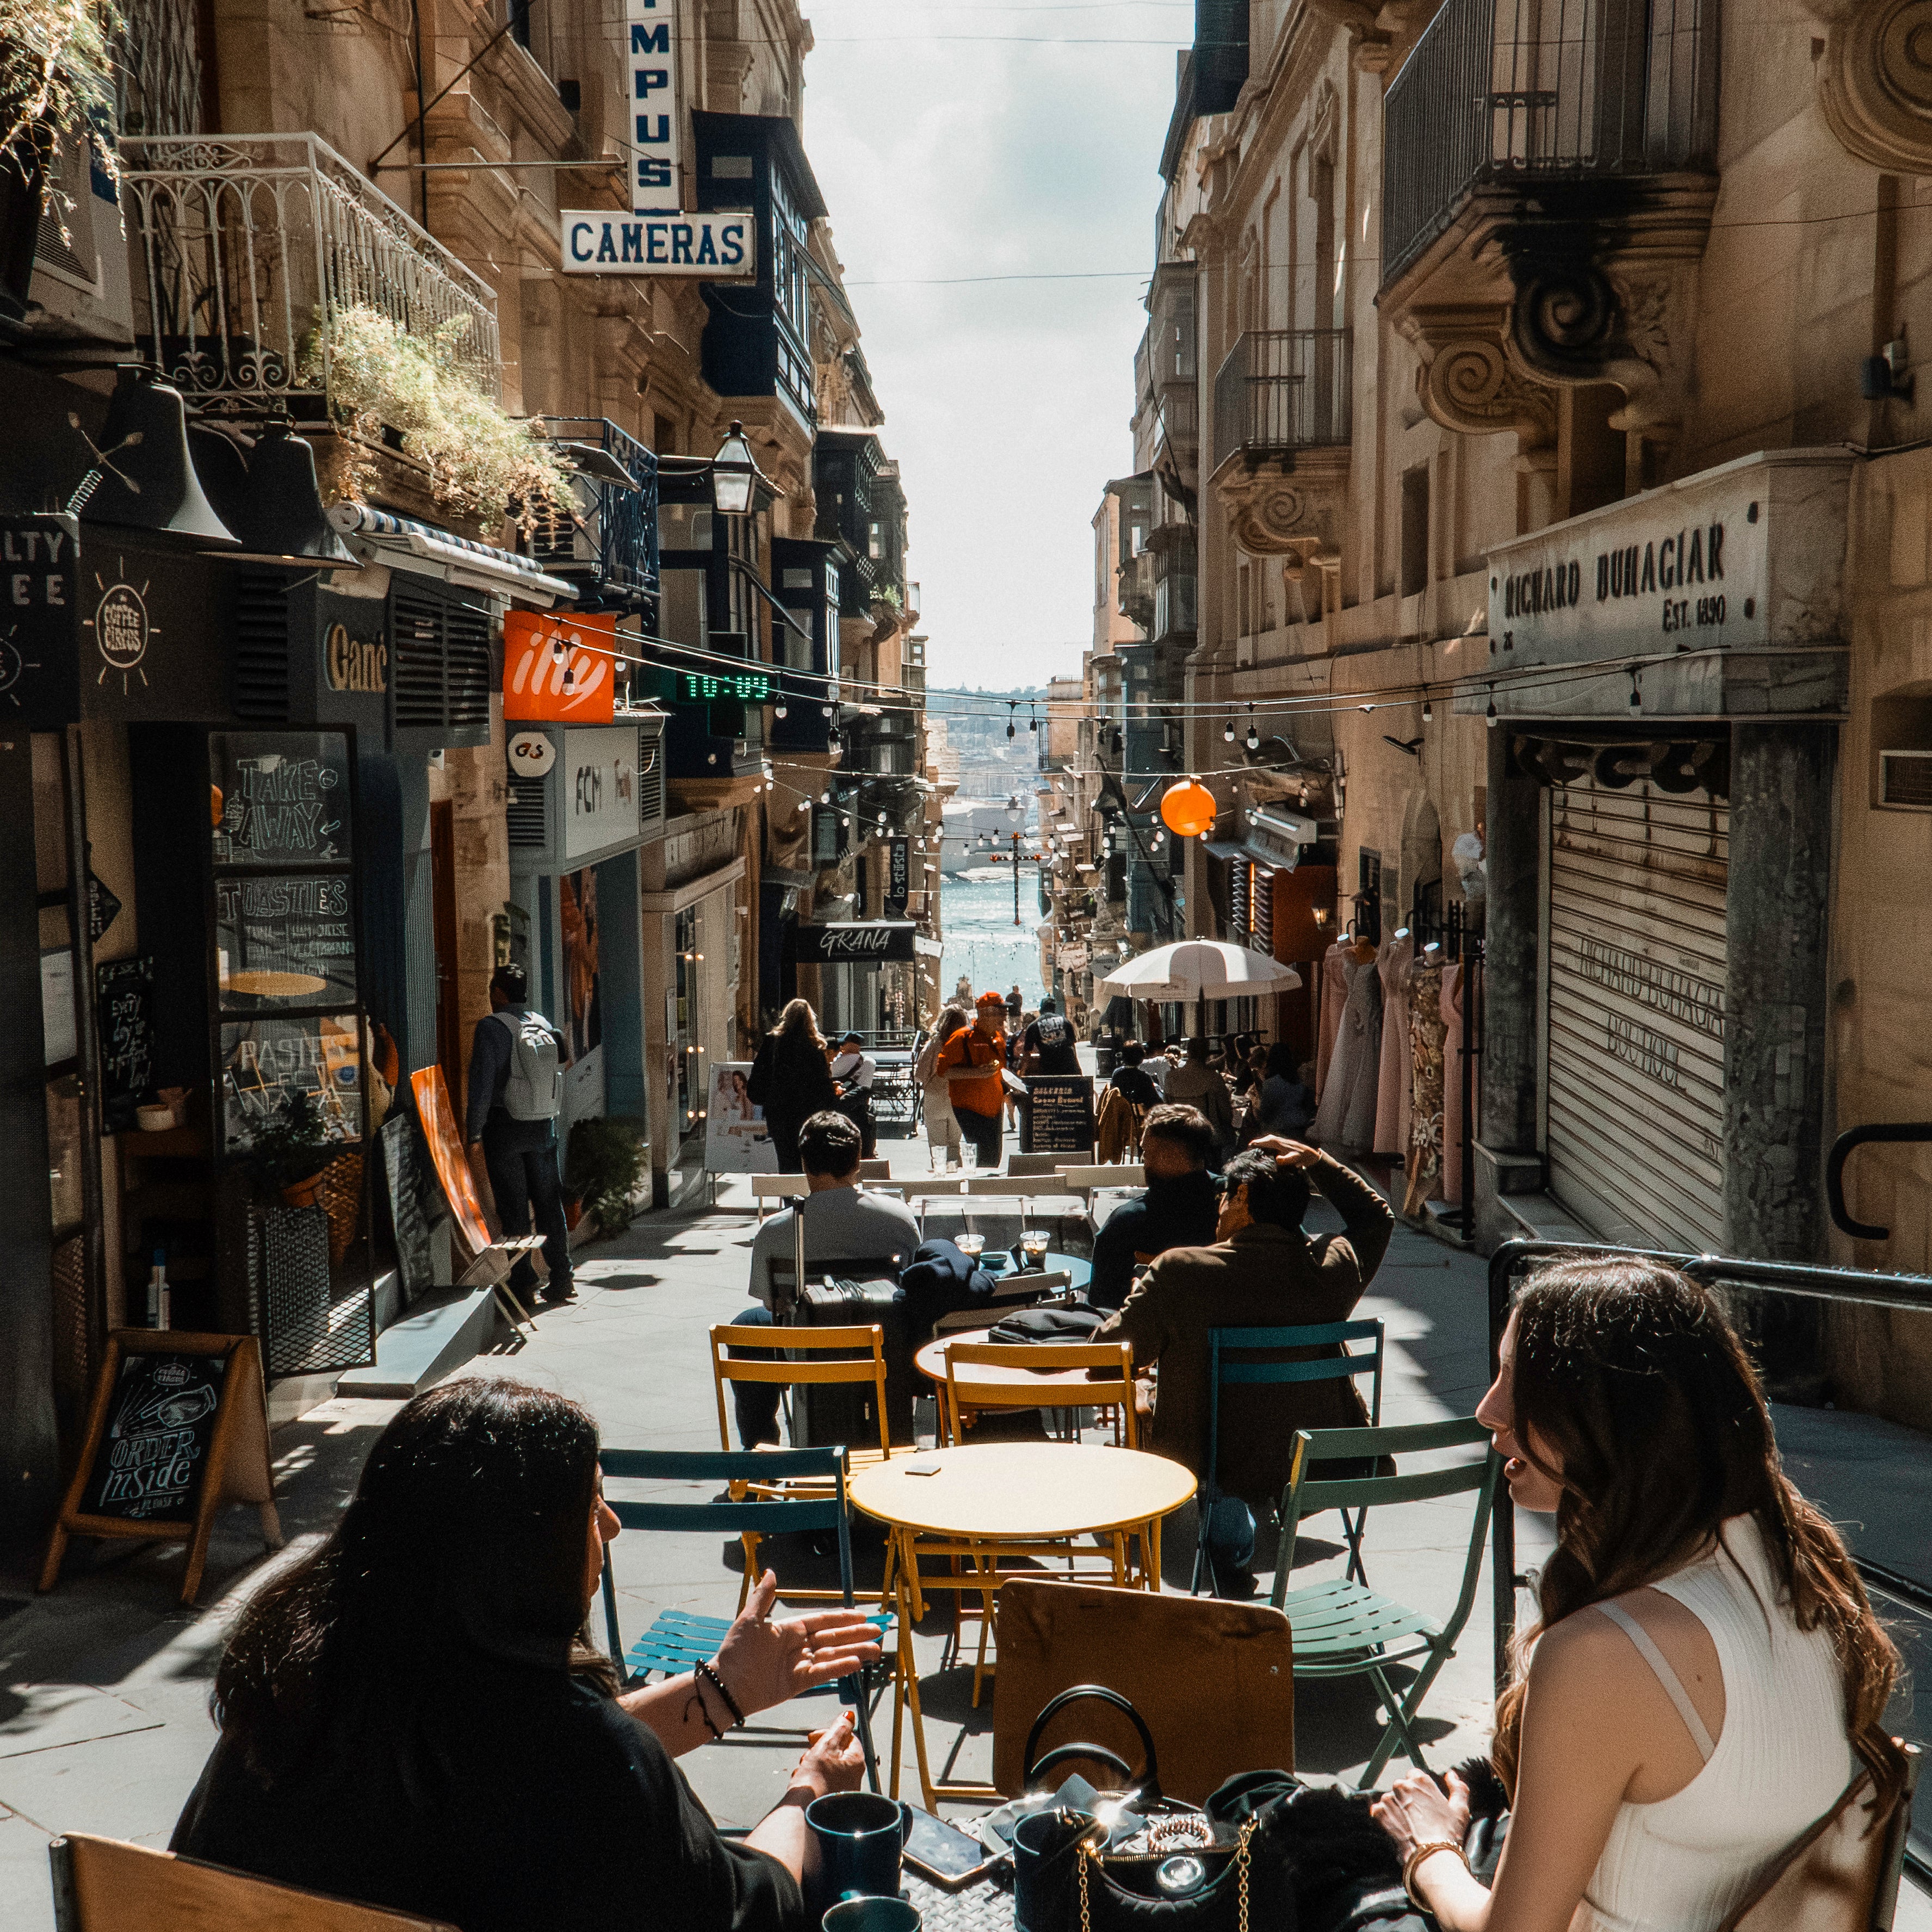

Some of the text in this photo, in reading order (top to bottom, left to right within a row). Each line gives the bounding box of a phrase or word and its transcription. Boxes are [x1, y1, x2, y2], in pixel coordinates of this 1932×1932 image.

[631, 0, 671, 187] MPUS
[571, 222, 744, 266] CAMERAS
[1, 530, 65, 563] LTY
[1504, 522, 1725, 619] RICHARD BUHAGIAR
[512, 628, 609, 712] illy
[237, 759, 318, 802] TAKE
[239, 802, 323, 850] AWAY
[819, 927, 892, 958] GRANA
[110, 1430, 201, 1467] ORDER
